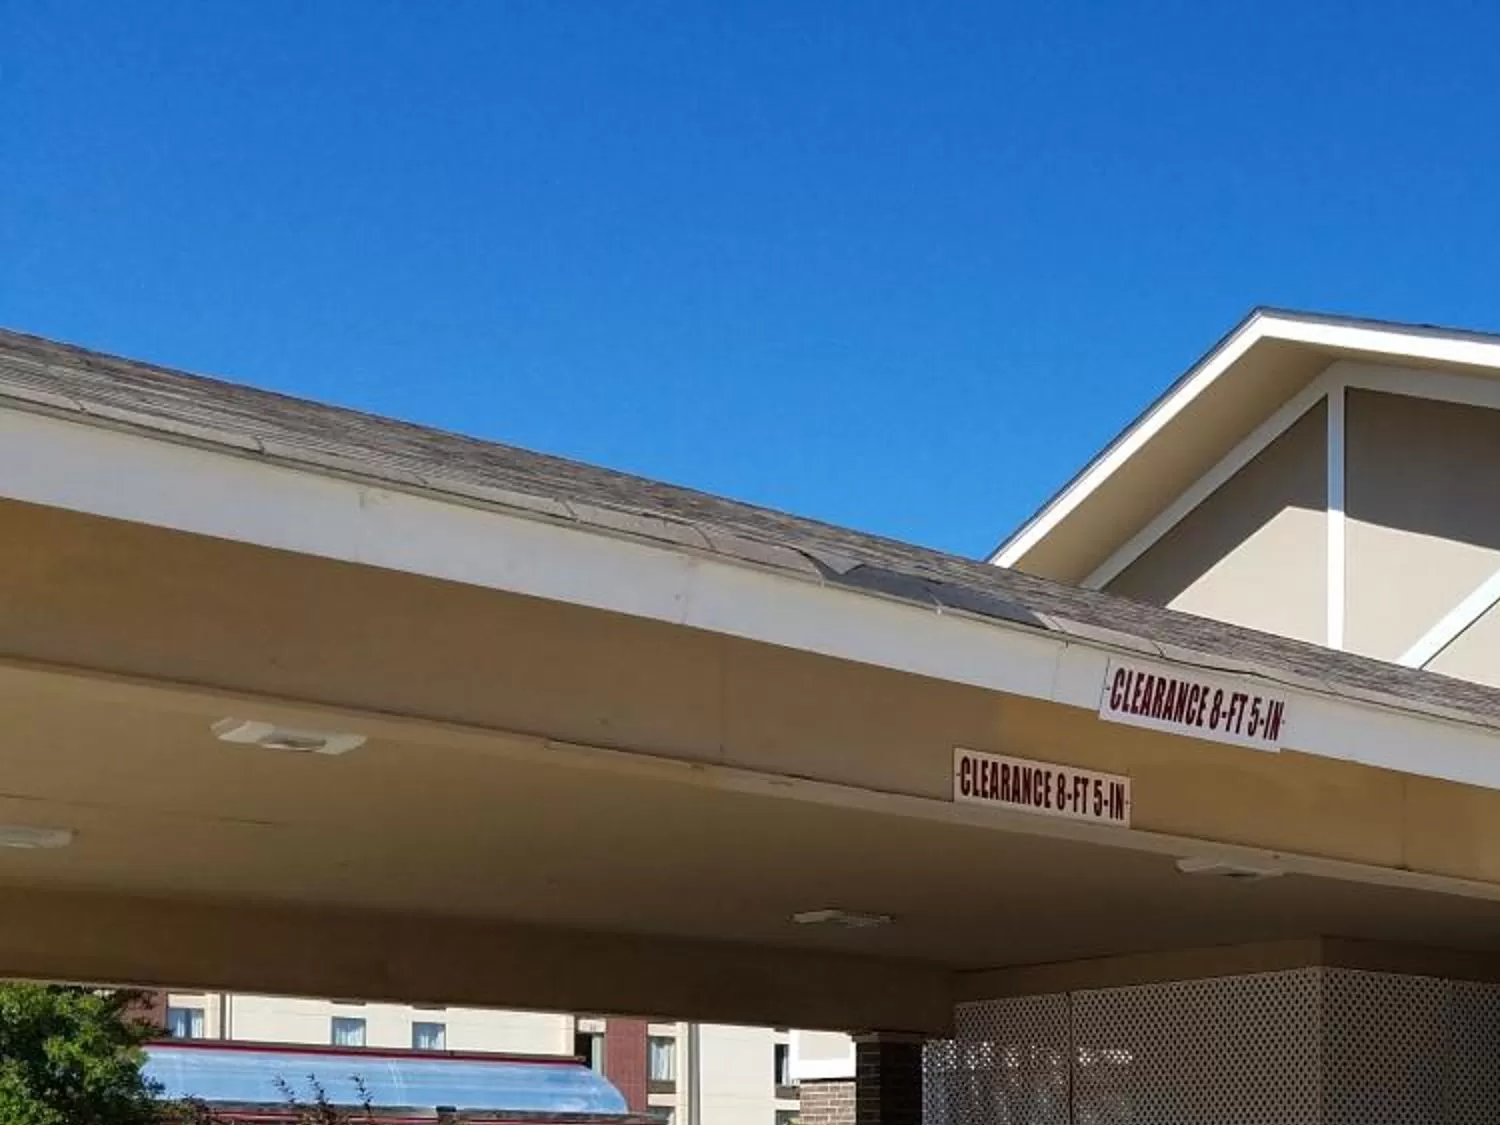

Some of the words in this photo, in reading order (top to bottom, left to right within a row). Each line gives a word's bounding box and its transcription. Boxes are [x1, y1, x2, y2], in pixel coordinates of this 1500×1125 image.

[1109, 667, 1210, 727] CLEARANCE
[1209, 688, 1248, 735] 8-FT
[1247, 696, 1285, 741] 5-IN
[960, 755, 1052, 809] CLEARANCE
[1056, 772, 1089, 814] 8-FT
[1093, 778, 1125, 821] 5-IN
